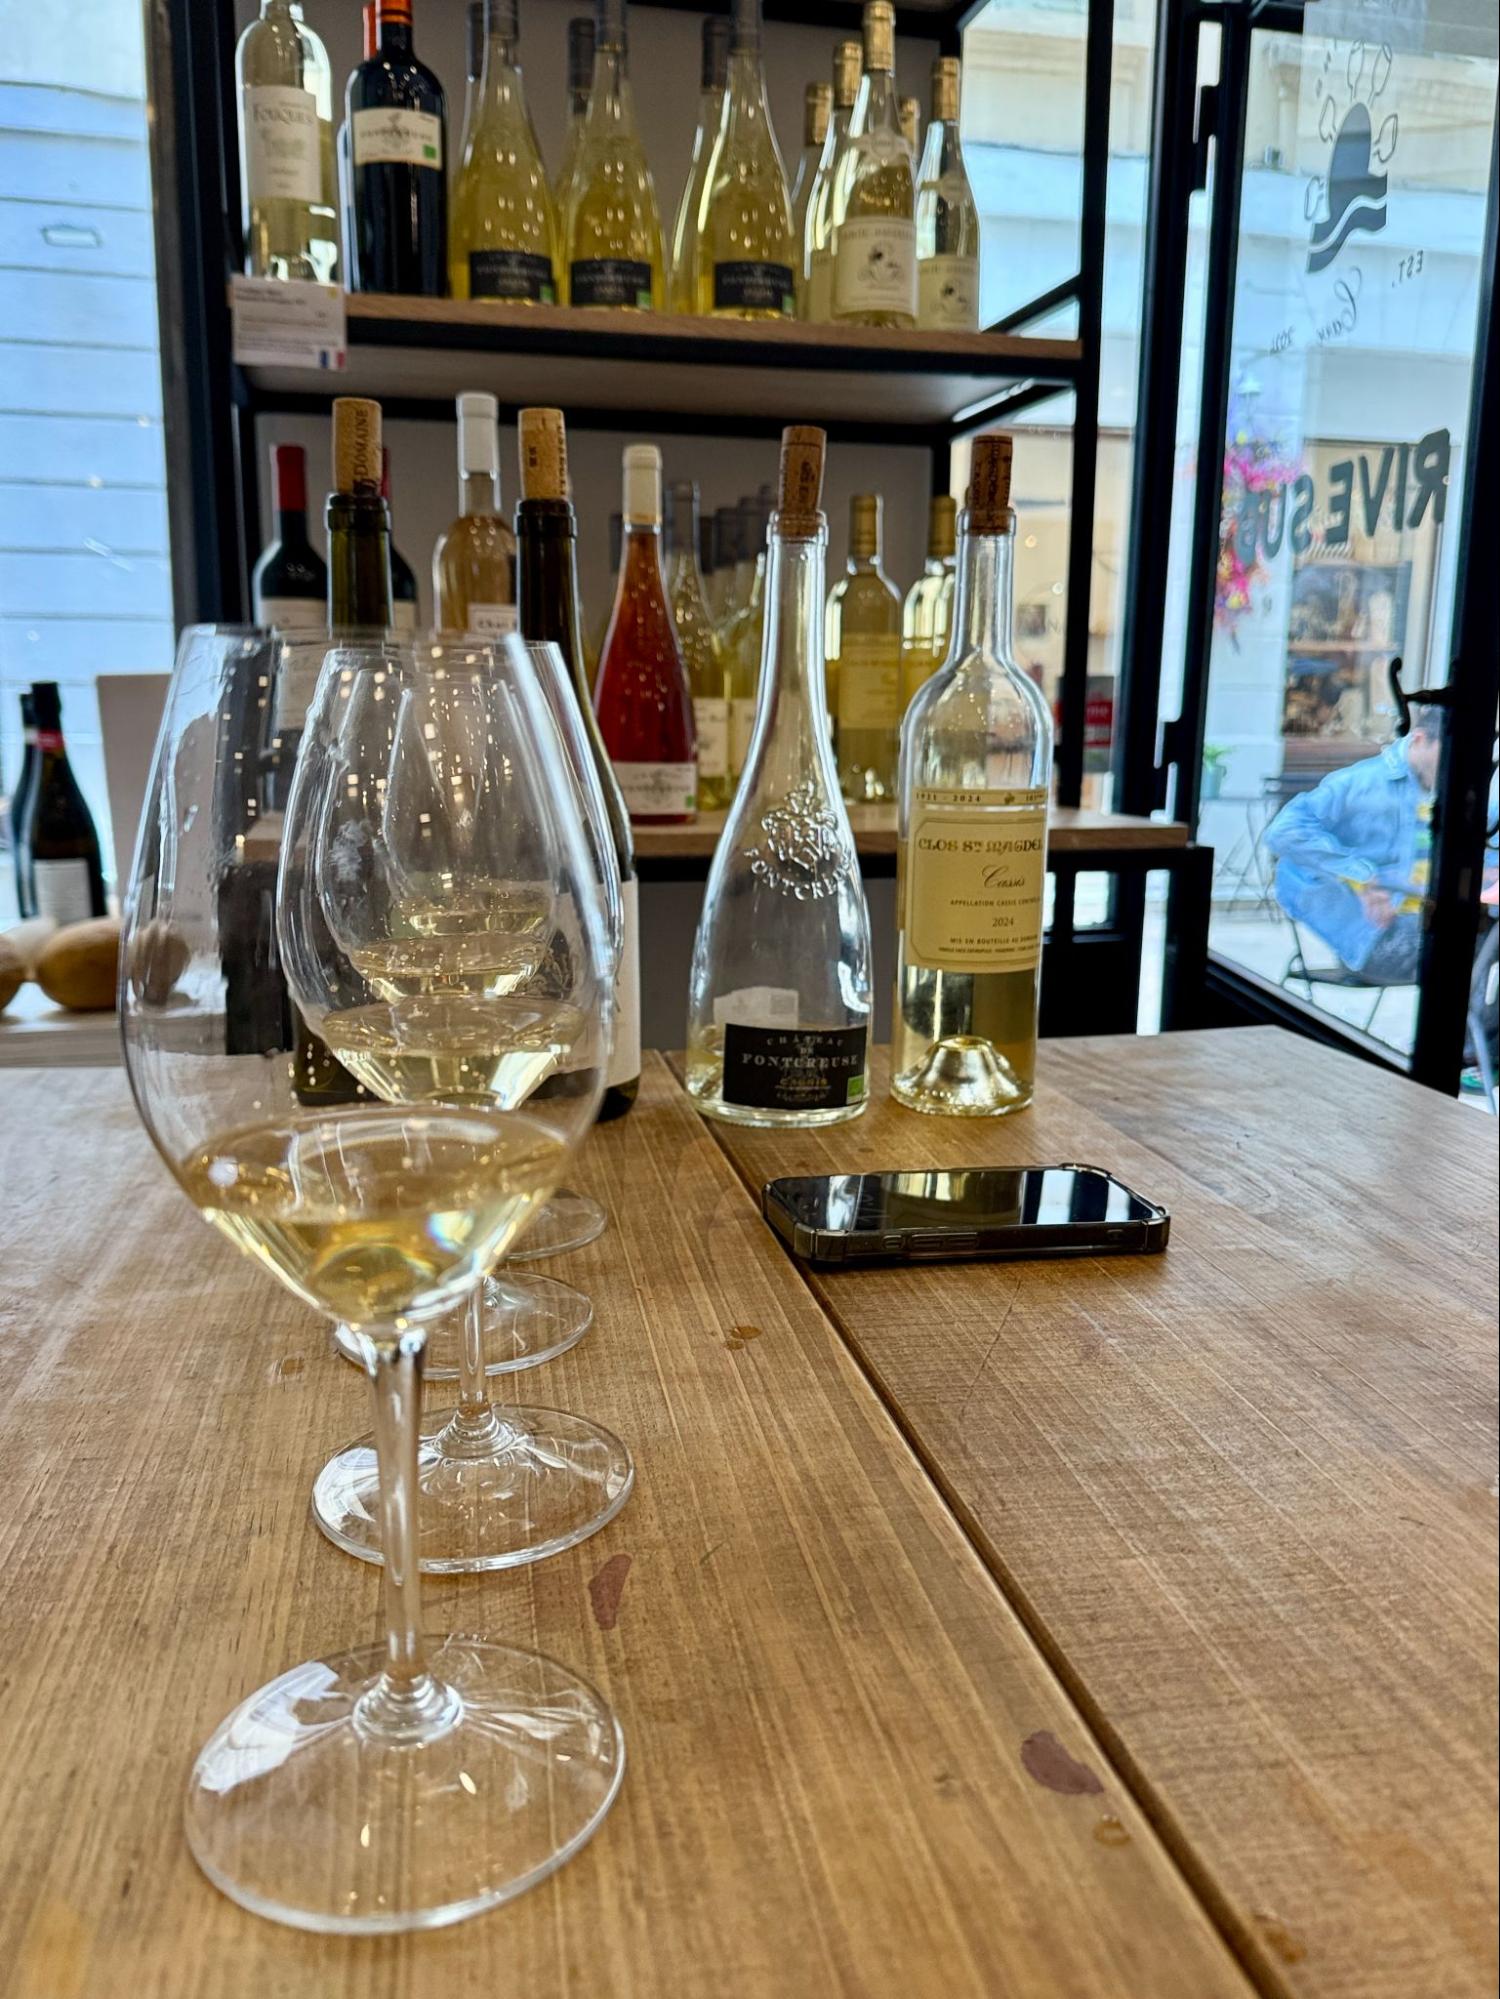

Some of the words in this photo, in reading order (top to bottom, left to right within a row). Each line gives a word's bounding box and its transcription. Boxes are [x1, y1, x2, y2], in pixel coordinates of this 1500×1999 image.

[353, 410, 370, 477] DOMAINE
[953, 794, 982, 802] 2024
[918, 838, 959, 853] CLOS
[992, 917, 1014, 928] 2024
